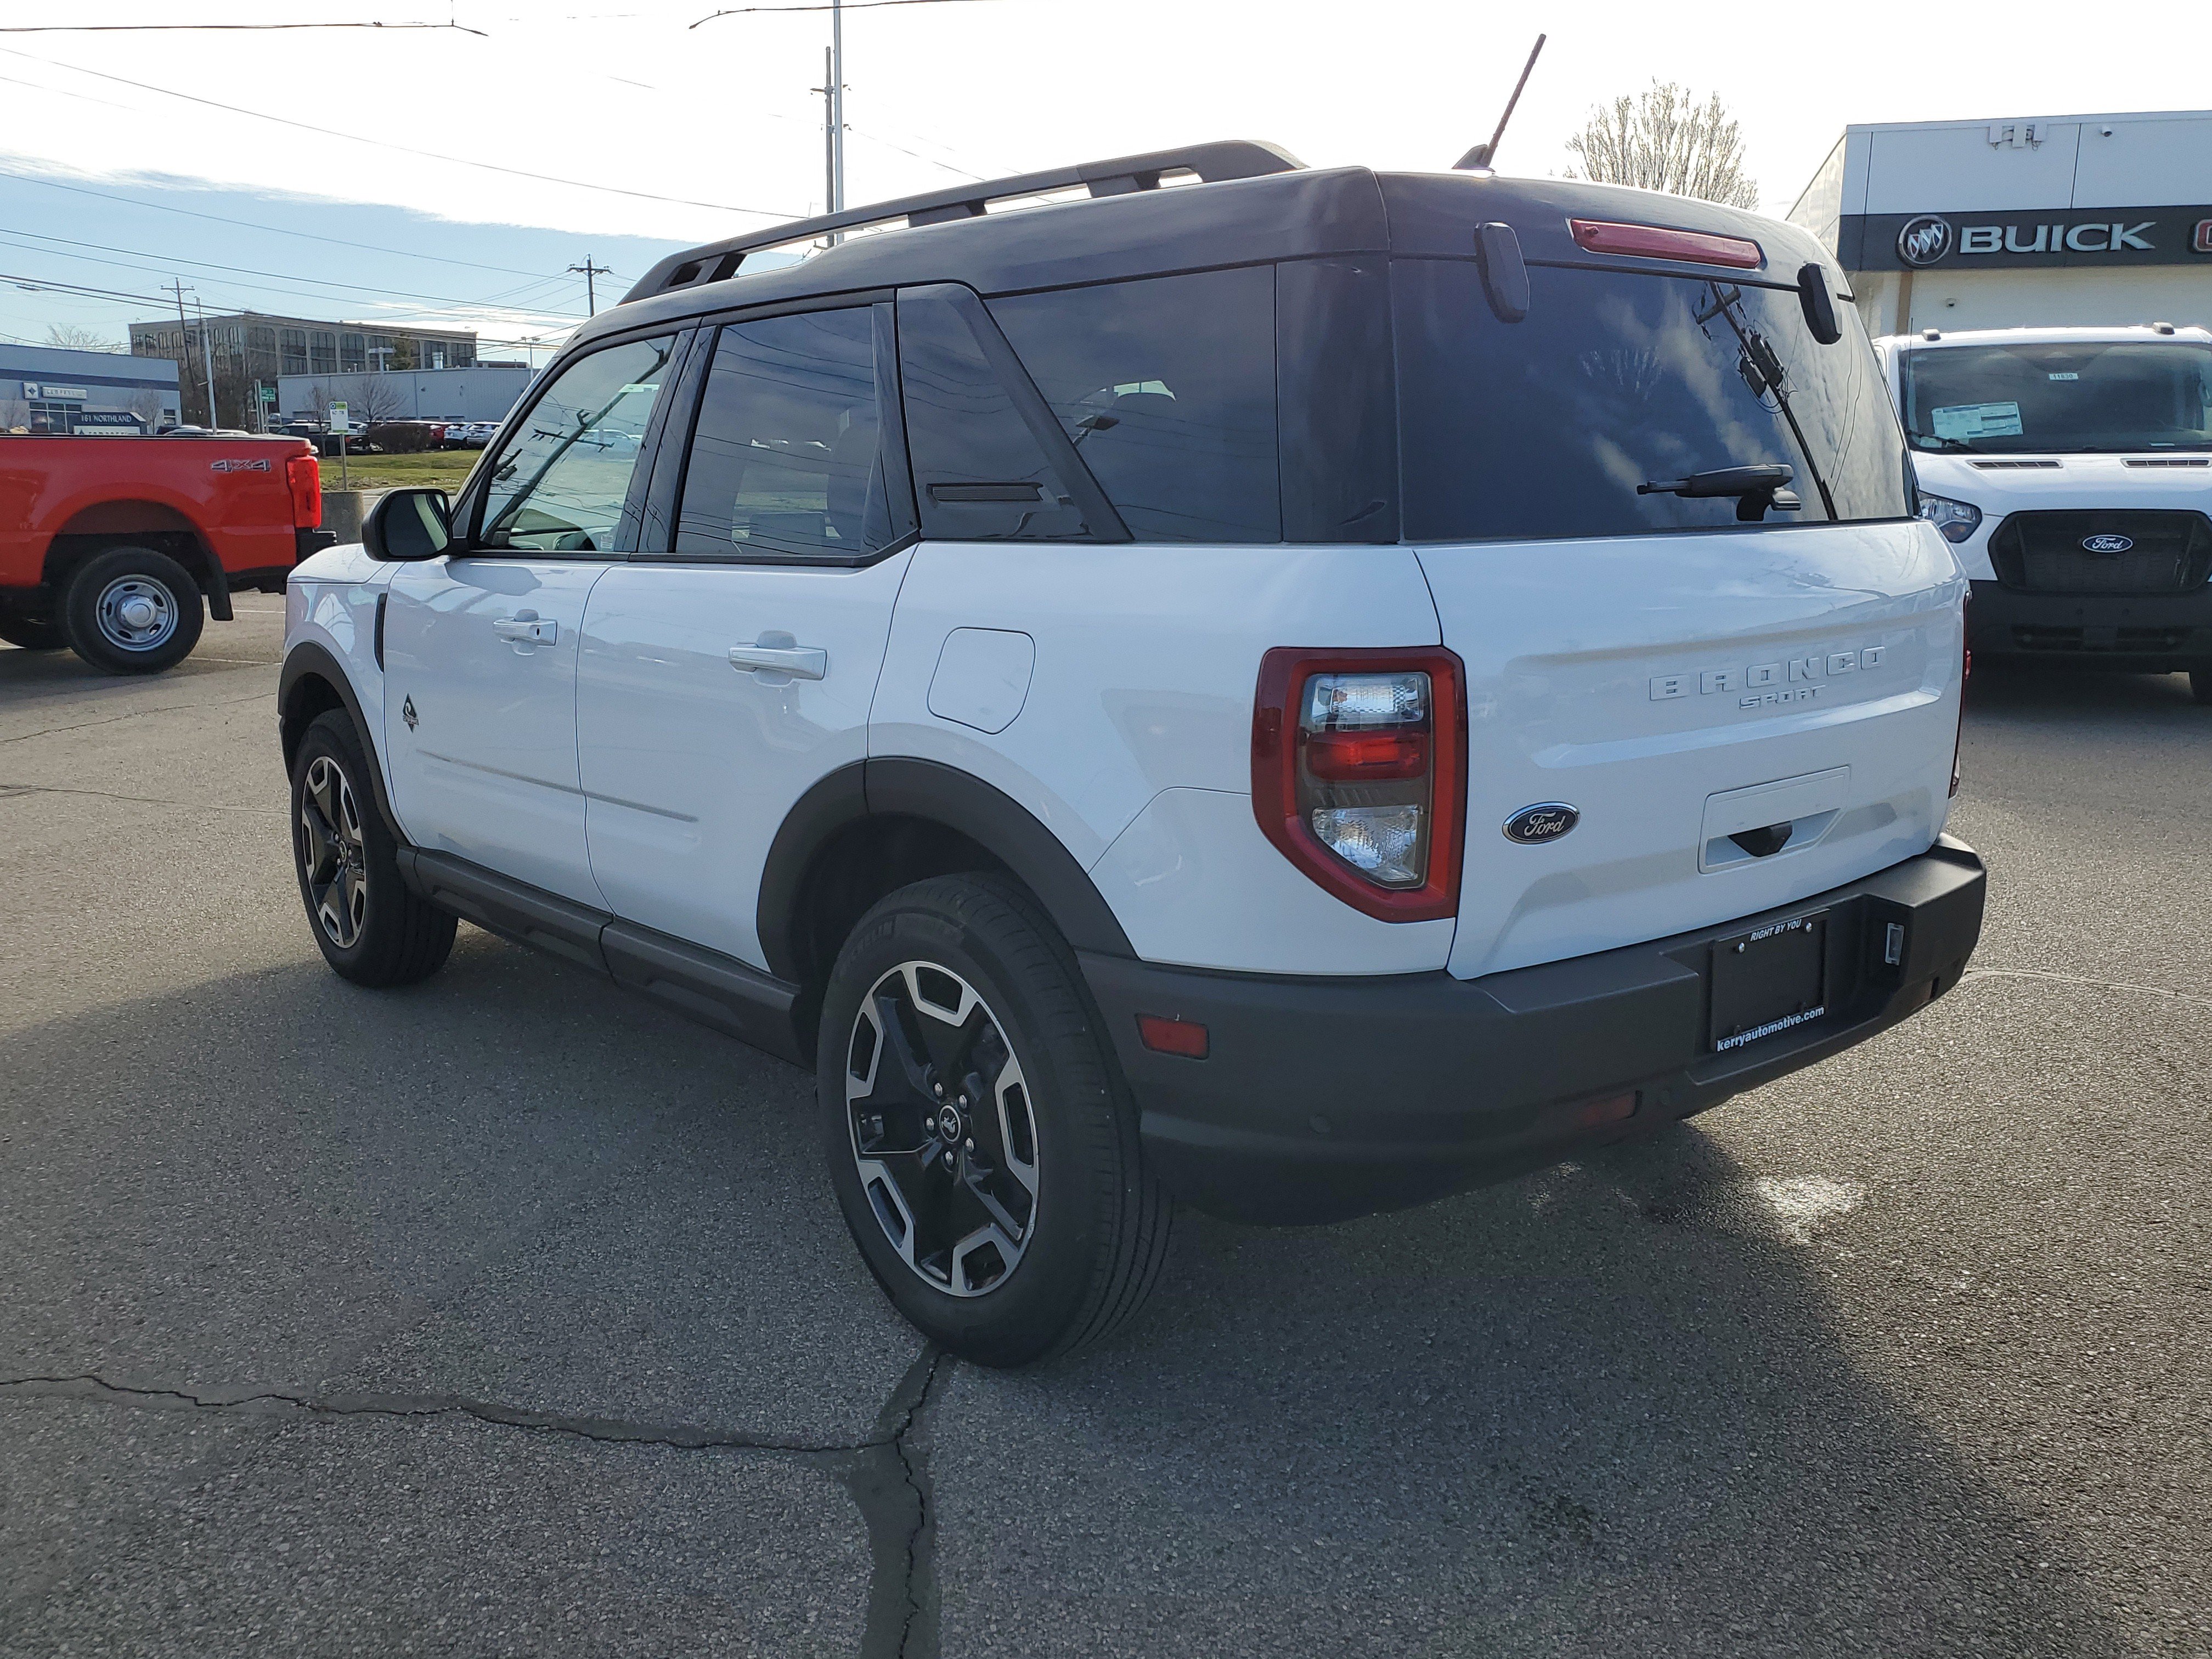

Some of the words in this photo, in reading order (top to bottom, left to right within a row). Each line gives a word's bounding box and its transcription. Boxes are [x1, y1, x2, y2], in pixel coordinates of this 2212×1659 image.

[1959, 221, 2157, 254] BUICK
[93, 415, 132, 423] NORTHLAND
[2091, 537, 2124, 549] Ford
[1649, 646, 1885, 701] BRONCO
[1739, 685, 1826, 709] SPORT
[1523, 811, 1566, 837] Ford
[1750, 927, 1775, 941] RIGHT
[1774, 923, 1786, 935] BY
[1787, 918, 1802, 931] YOU
[1717, 1006, 1825, 1052] kerryautomotive.com
